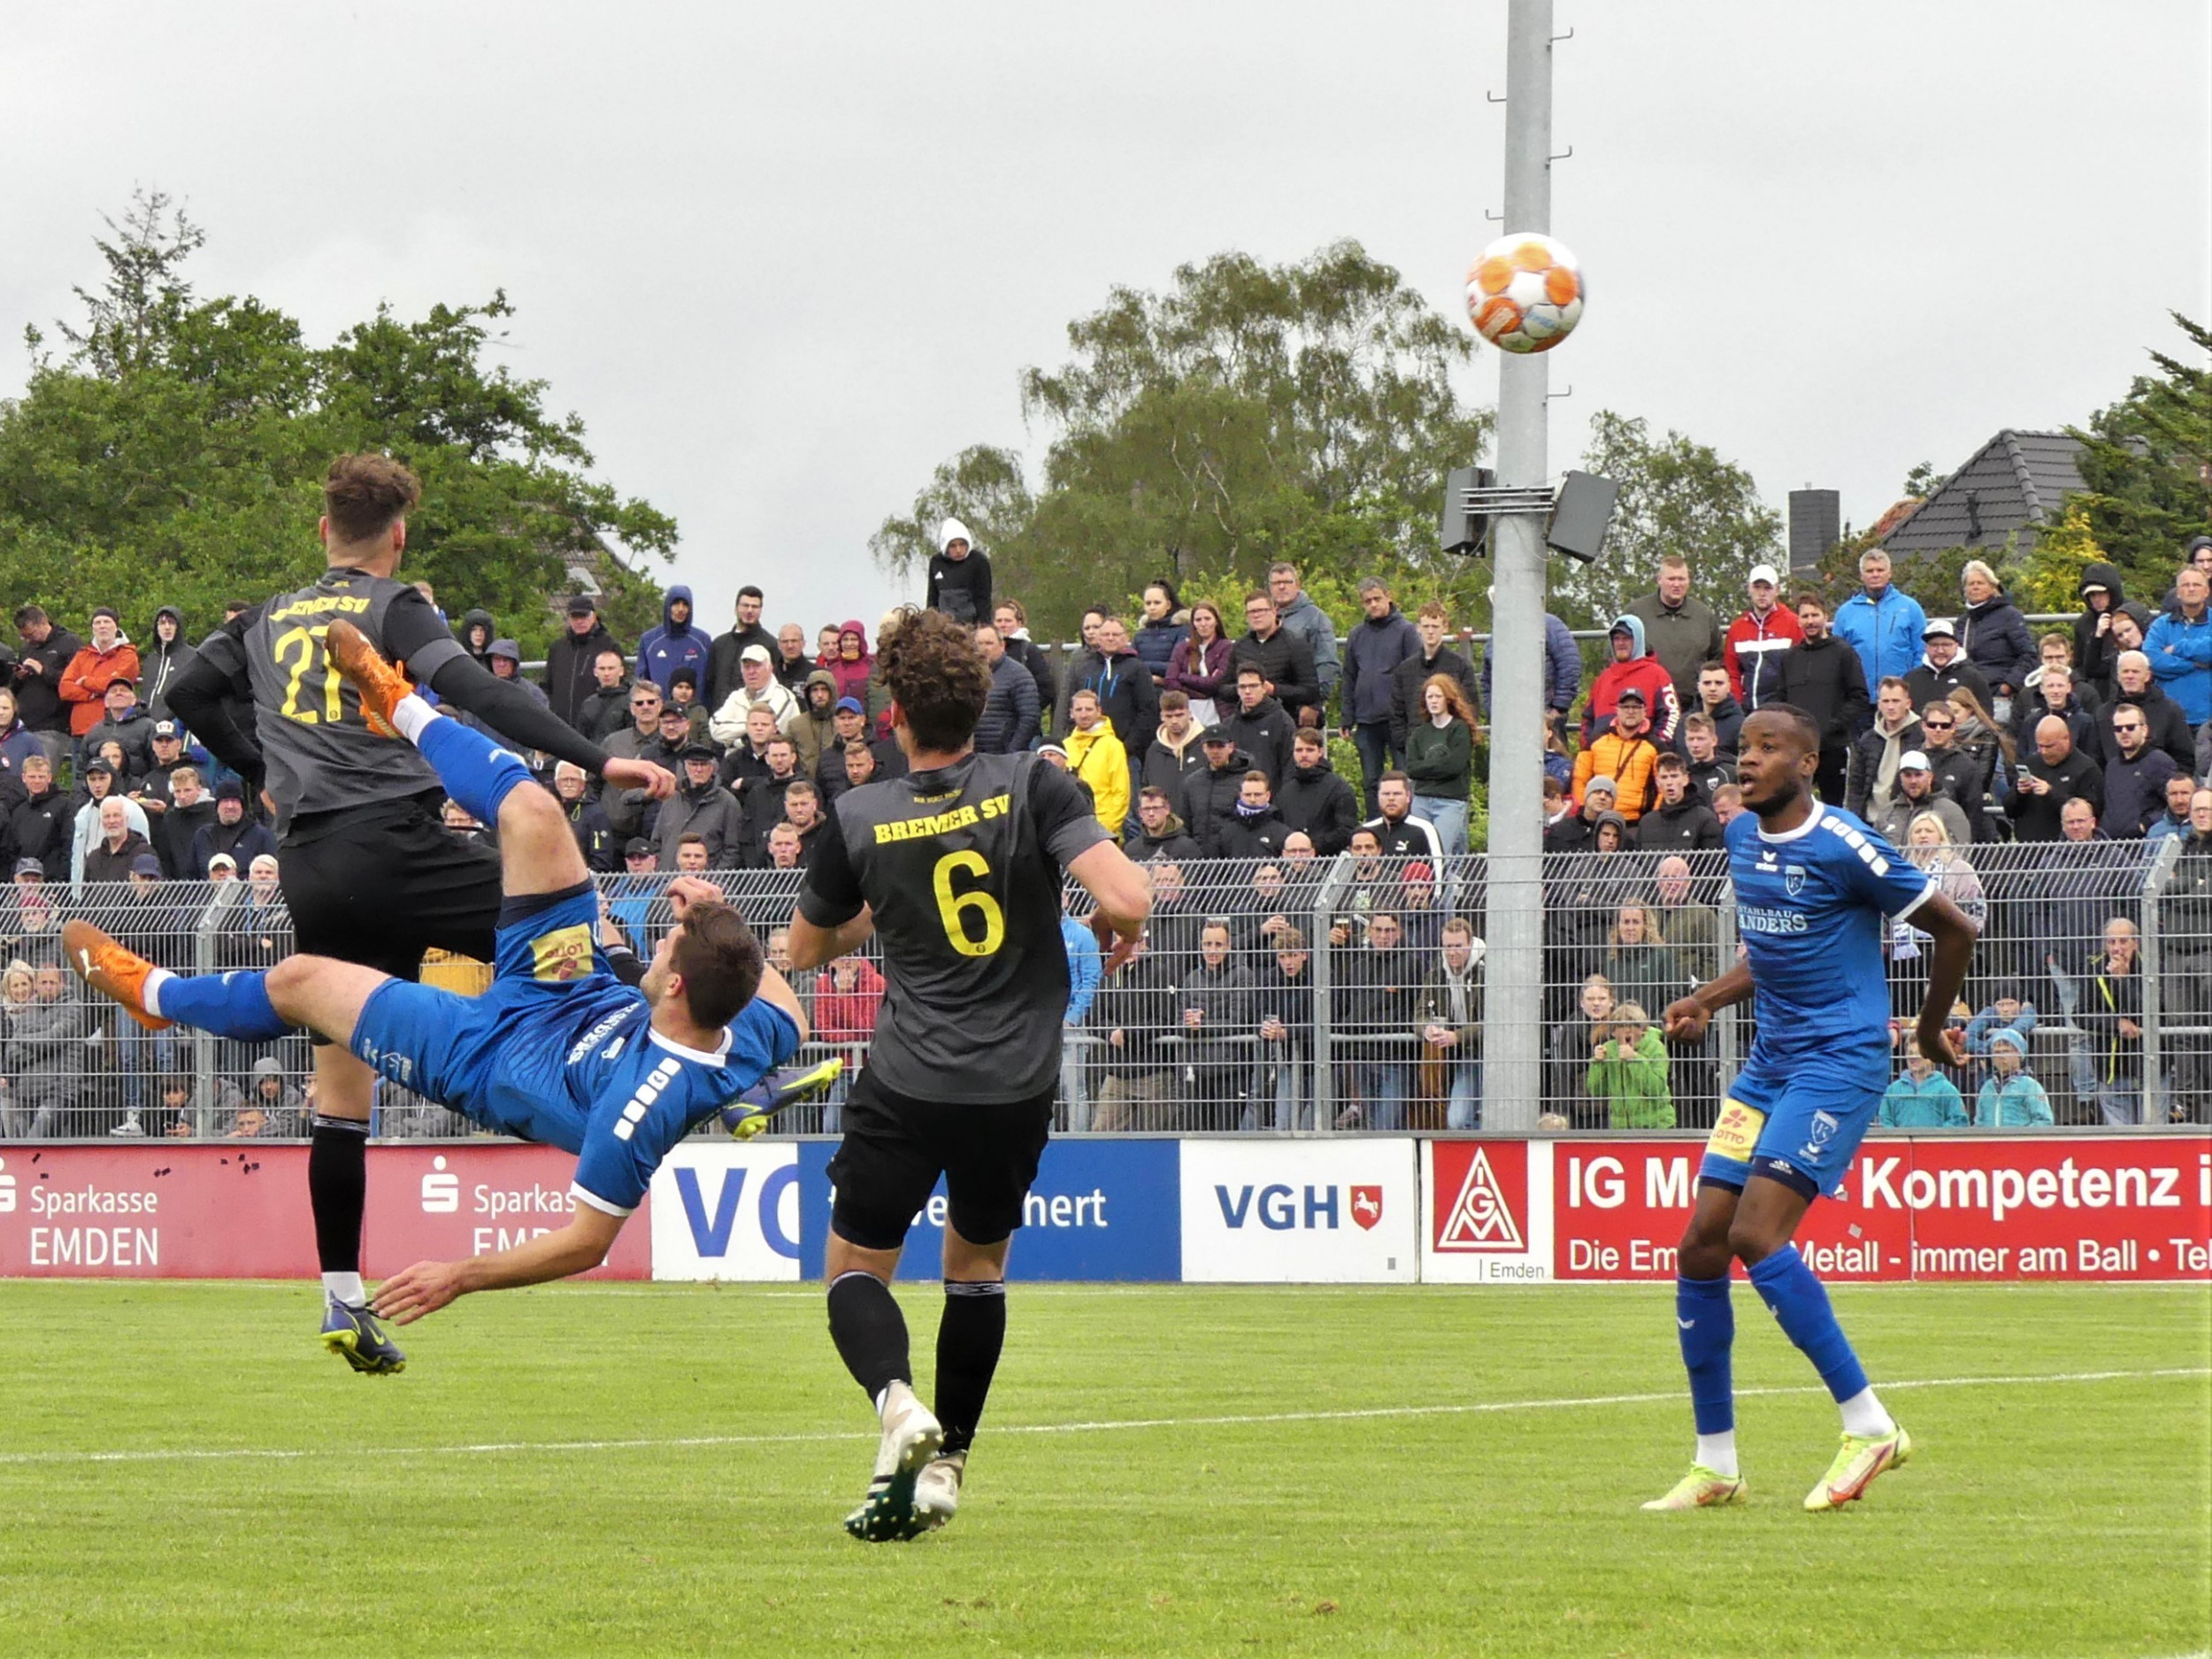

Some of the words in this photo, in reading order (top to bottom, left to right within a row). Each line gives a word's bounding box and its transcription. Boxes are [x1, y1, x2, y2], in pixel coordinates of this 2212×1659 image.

[275, 625, 342, 725] 21
[873, 805, 979, 844] BREMER
[980, 794, 1010, 819] SV
[933, 849, 1006, 956] 6
[1738, 904, 1793, 918] STAHLBAU
[1738, 913, 1809, 933] ANDERS
[1712, 1129, 1745, 1145] OTTO
[1570, 1156, 1625, 1209] IG
[1863, 1157, 2181, 1221] Kompetenz
[30, 1185, 157, 1220] Sparkasse
[473, 1183, 577, 1220] Sparkas
[1215, 1184, 1339, 1231] VGH
[30, 1226, 158, 1266] EMDEN
[1570, 1240, 1619, 1271] Die
[1789, 1240, 1878, 1272] Metall
[1912, 1240, 2010, 1272] immer
[2018, 1248, 2068, 1271] am
[2078, 1240, 2137, 1271] Ball
[1490, 1262, 1544, 1279] Emden
